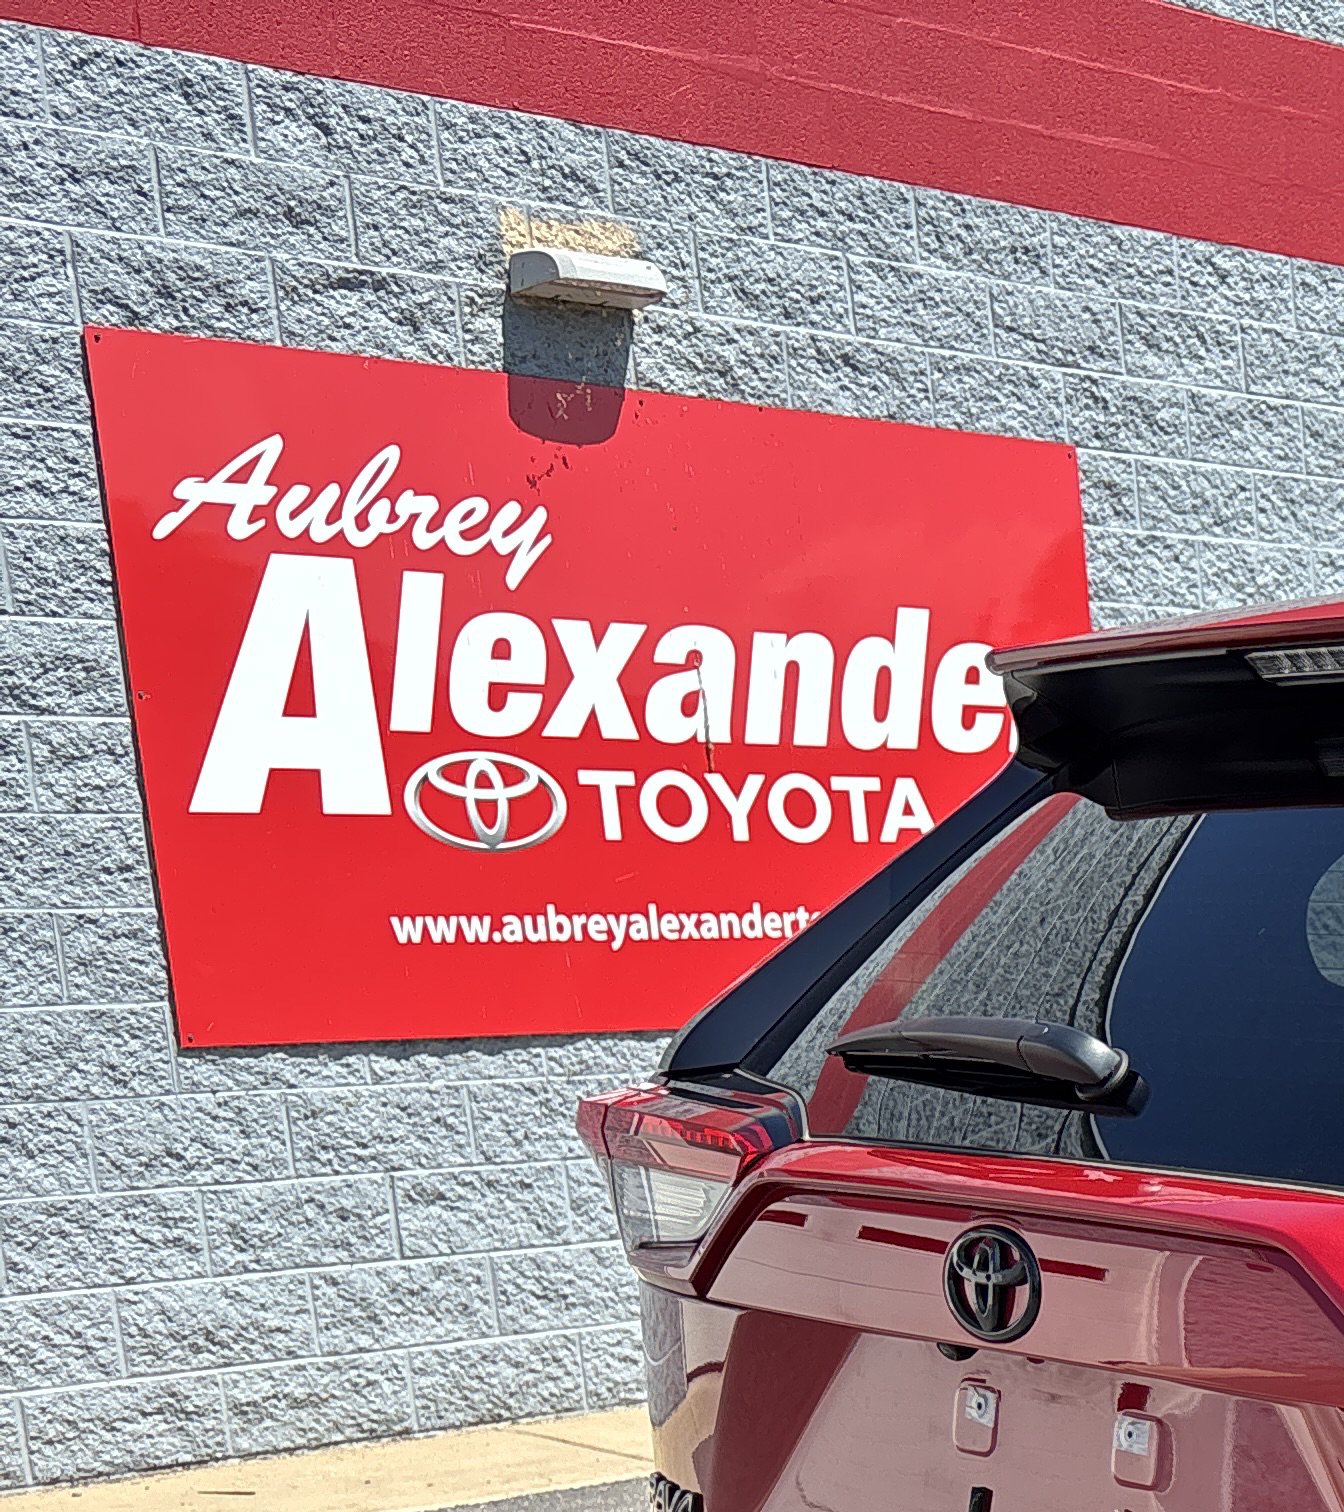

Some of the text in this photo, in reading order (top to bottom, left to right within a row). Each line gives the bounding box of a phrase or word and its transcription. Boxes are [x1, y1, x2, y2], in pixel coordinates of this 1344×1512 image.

[152, 433, 552, 591] Aubrey
[188, 552, 1019, 816] Alexande
[577, 768, 936, 844] TOYOTA
[389, 902, 822, 952] www.aubreyalexandert
